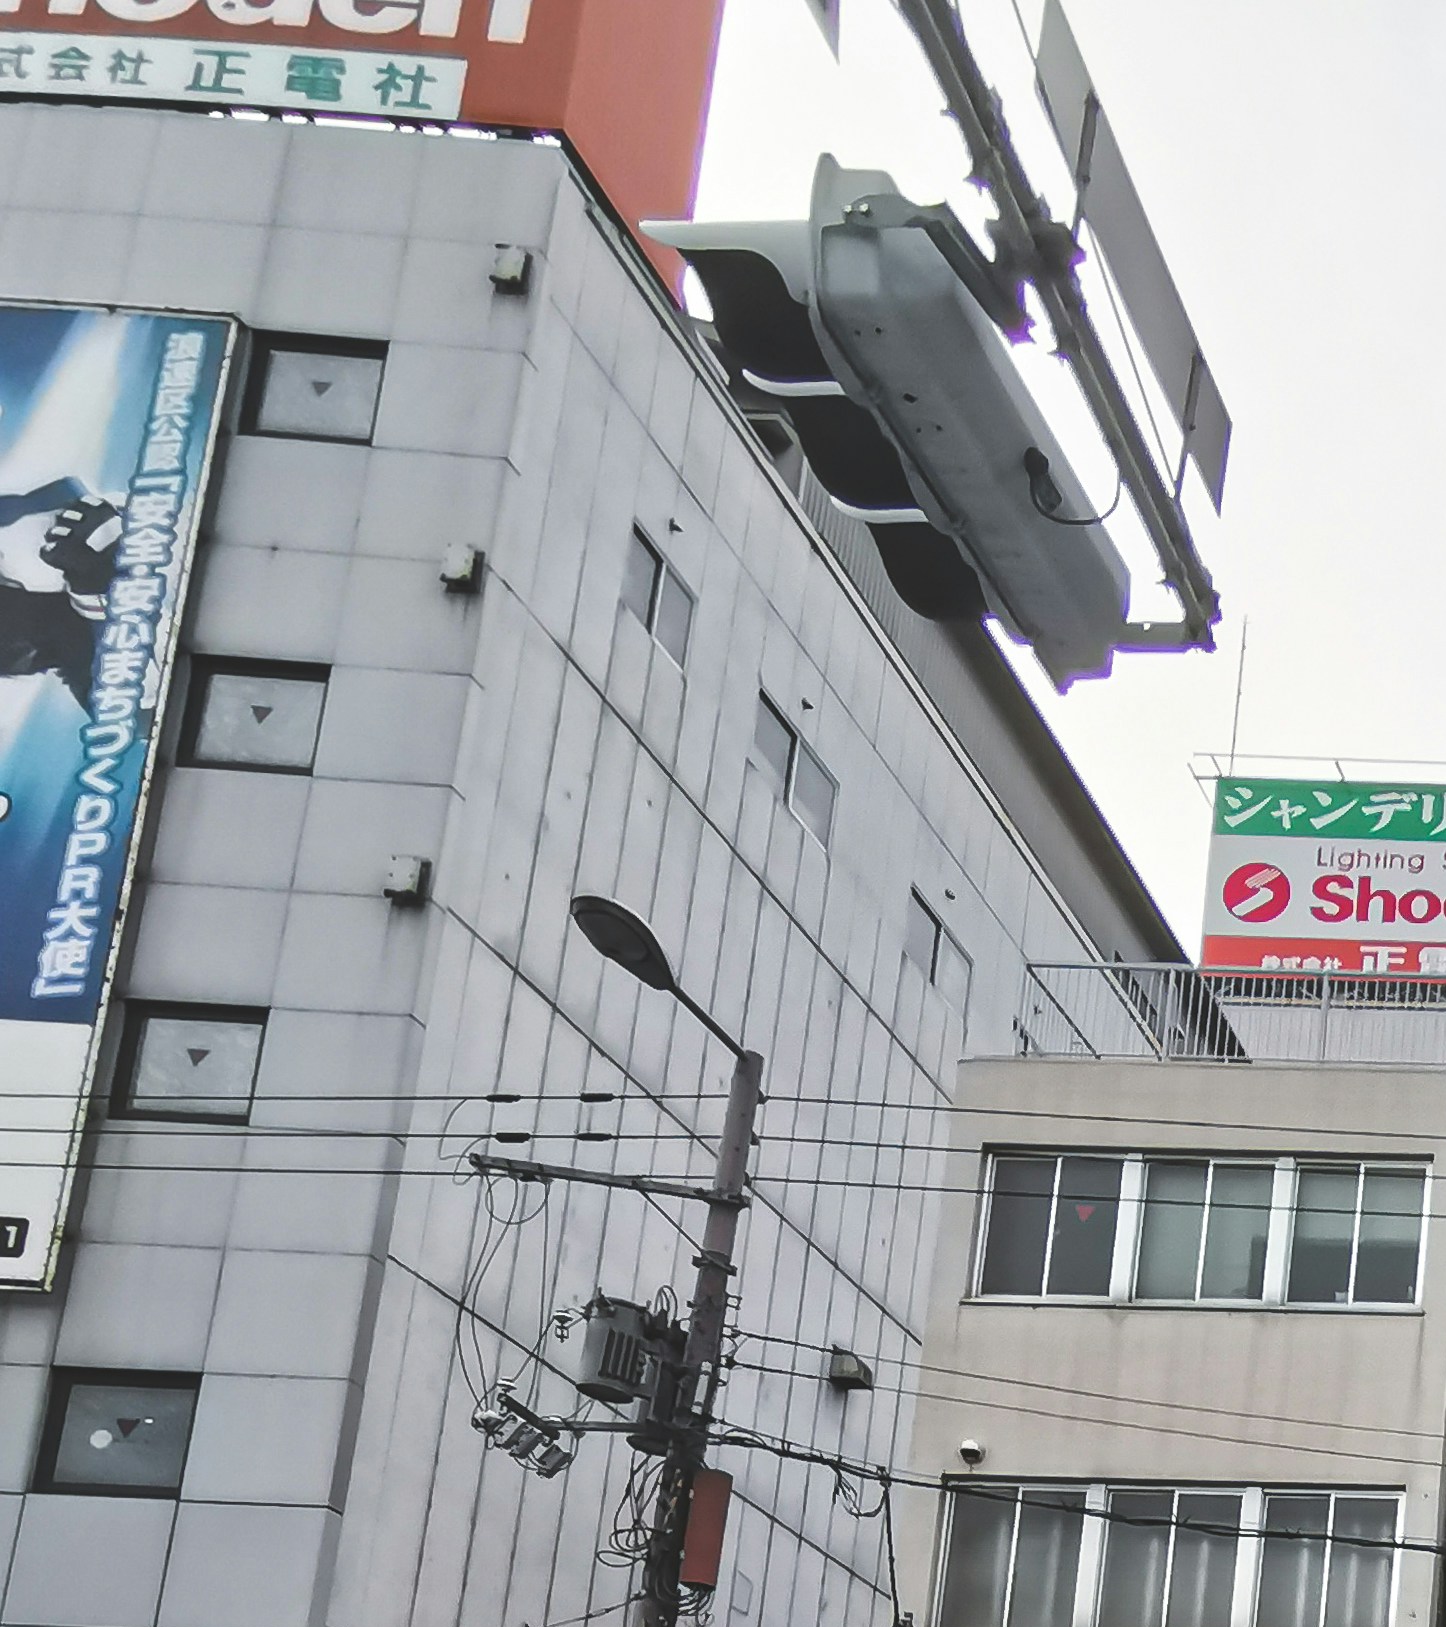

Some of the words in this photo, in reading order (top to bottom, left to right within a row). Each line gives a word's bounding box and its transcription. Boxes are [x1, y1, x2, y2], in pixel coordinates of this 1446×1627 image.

[185, 47, 438, 111] 正電社
[1316, 846, 1425, 873] Lighting
